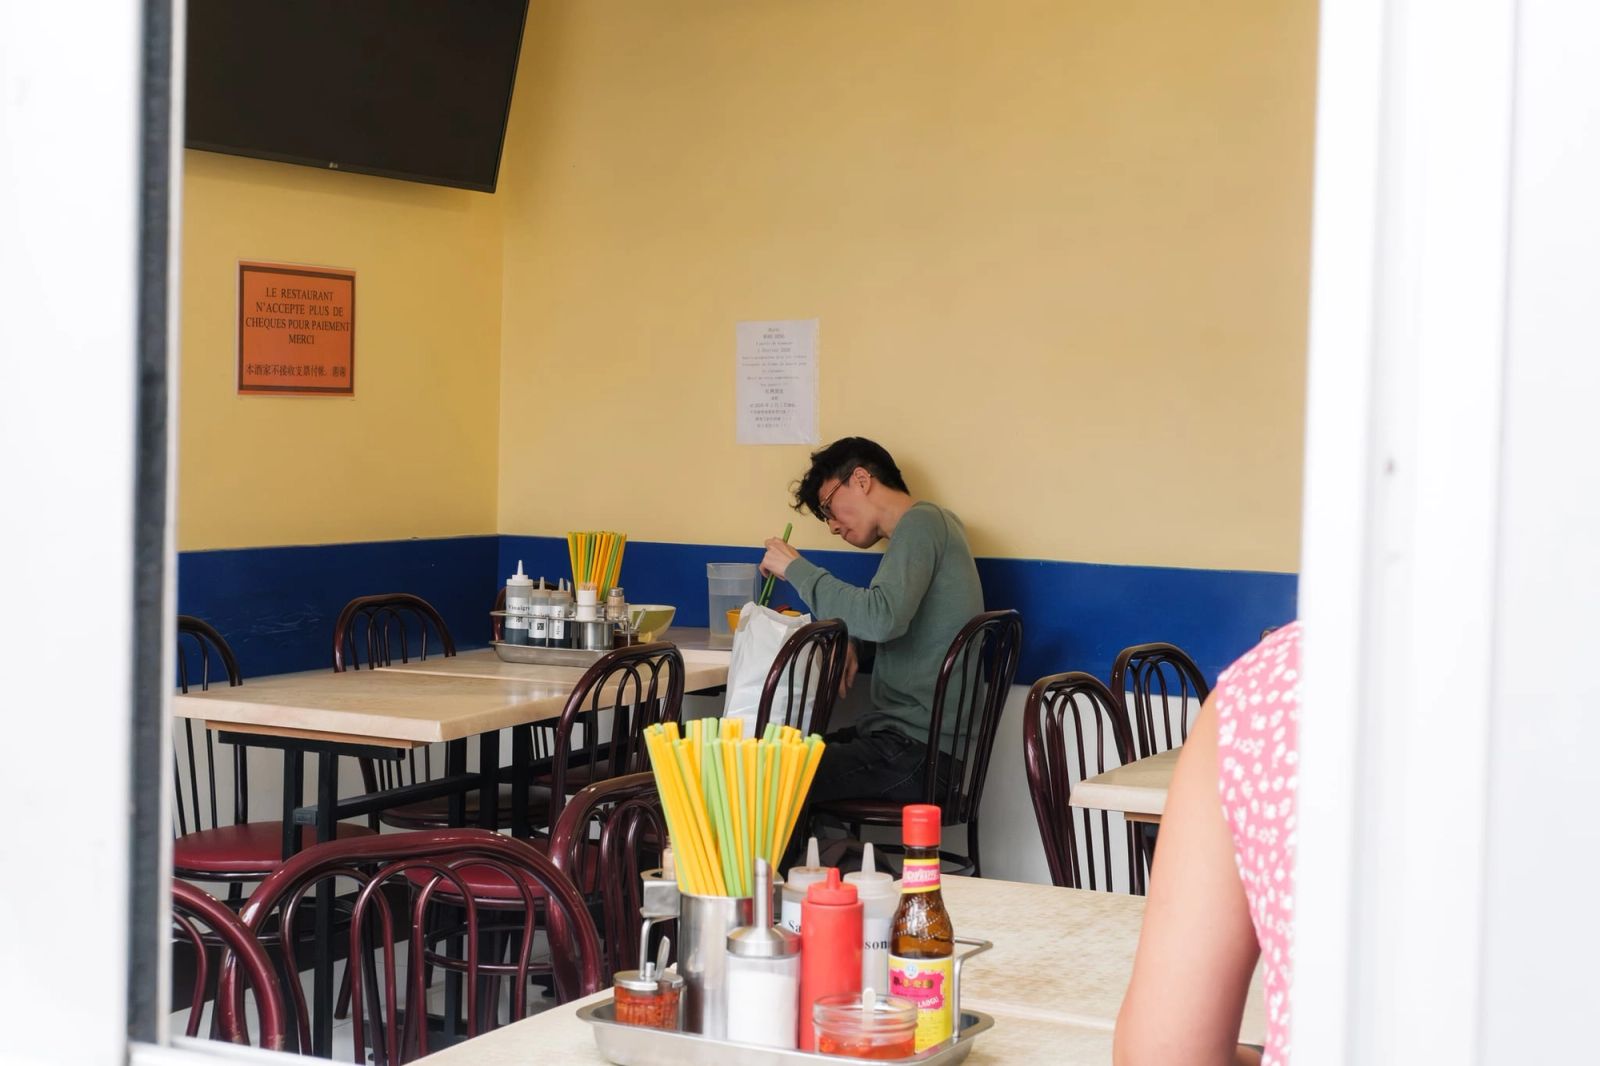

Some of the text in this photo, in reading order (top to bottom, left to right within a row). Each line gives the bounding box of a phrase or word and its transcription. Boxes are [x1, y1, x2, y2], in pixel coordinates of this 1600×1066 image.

[266, 287, 334, 301] LE RESTAURANT
[256, 301, 344, 317] N'ACCEPTE PLUS DE
[288, 319, 312, 330] POUR
[312, 322, 351, 332] PAIEMENT
[289, 334, 315, 345] MERCI
